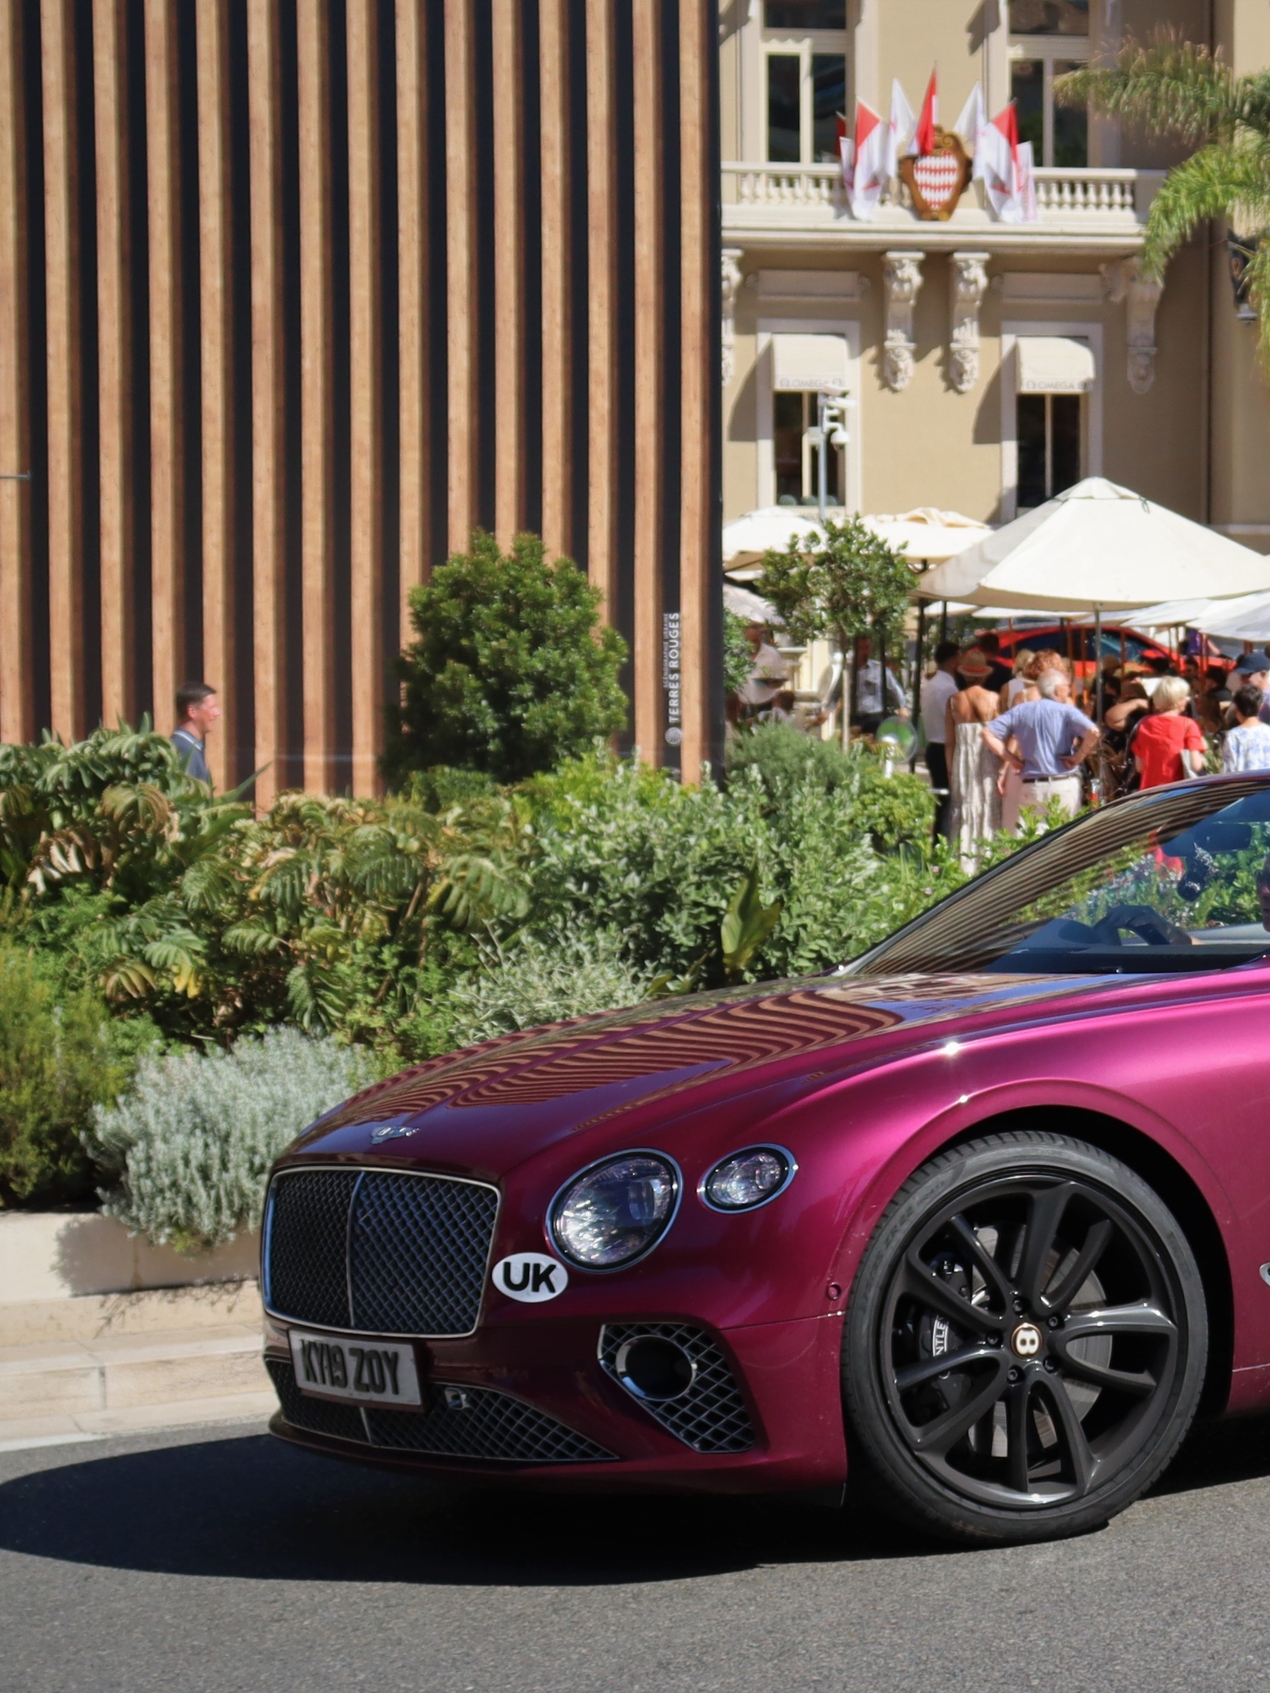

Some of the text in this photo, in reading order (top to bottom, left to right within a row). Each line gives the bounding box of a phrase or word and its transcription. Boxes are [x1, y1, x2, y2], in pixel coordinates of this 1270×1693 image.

[1038, 381, 1075, 390] OMEGA
[669, 612, 679, 724] TERRES ROUGES
[503, 1261, 557, 1294] UK
[300, 1339, 399, 1396] KY19 ZOY
